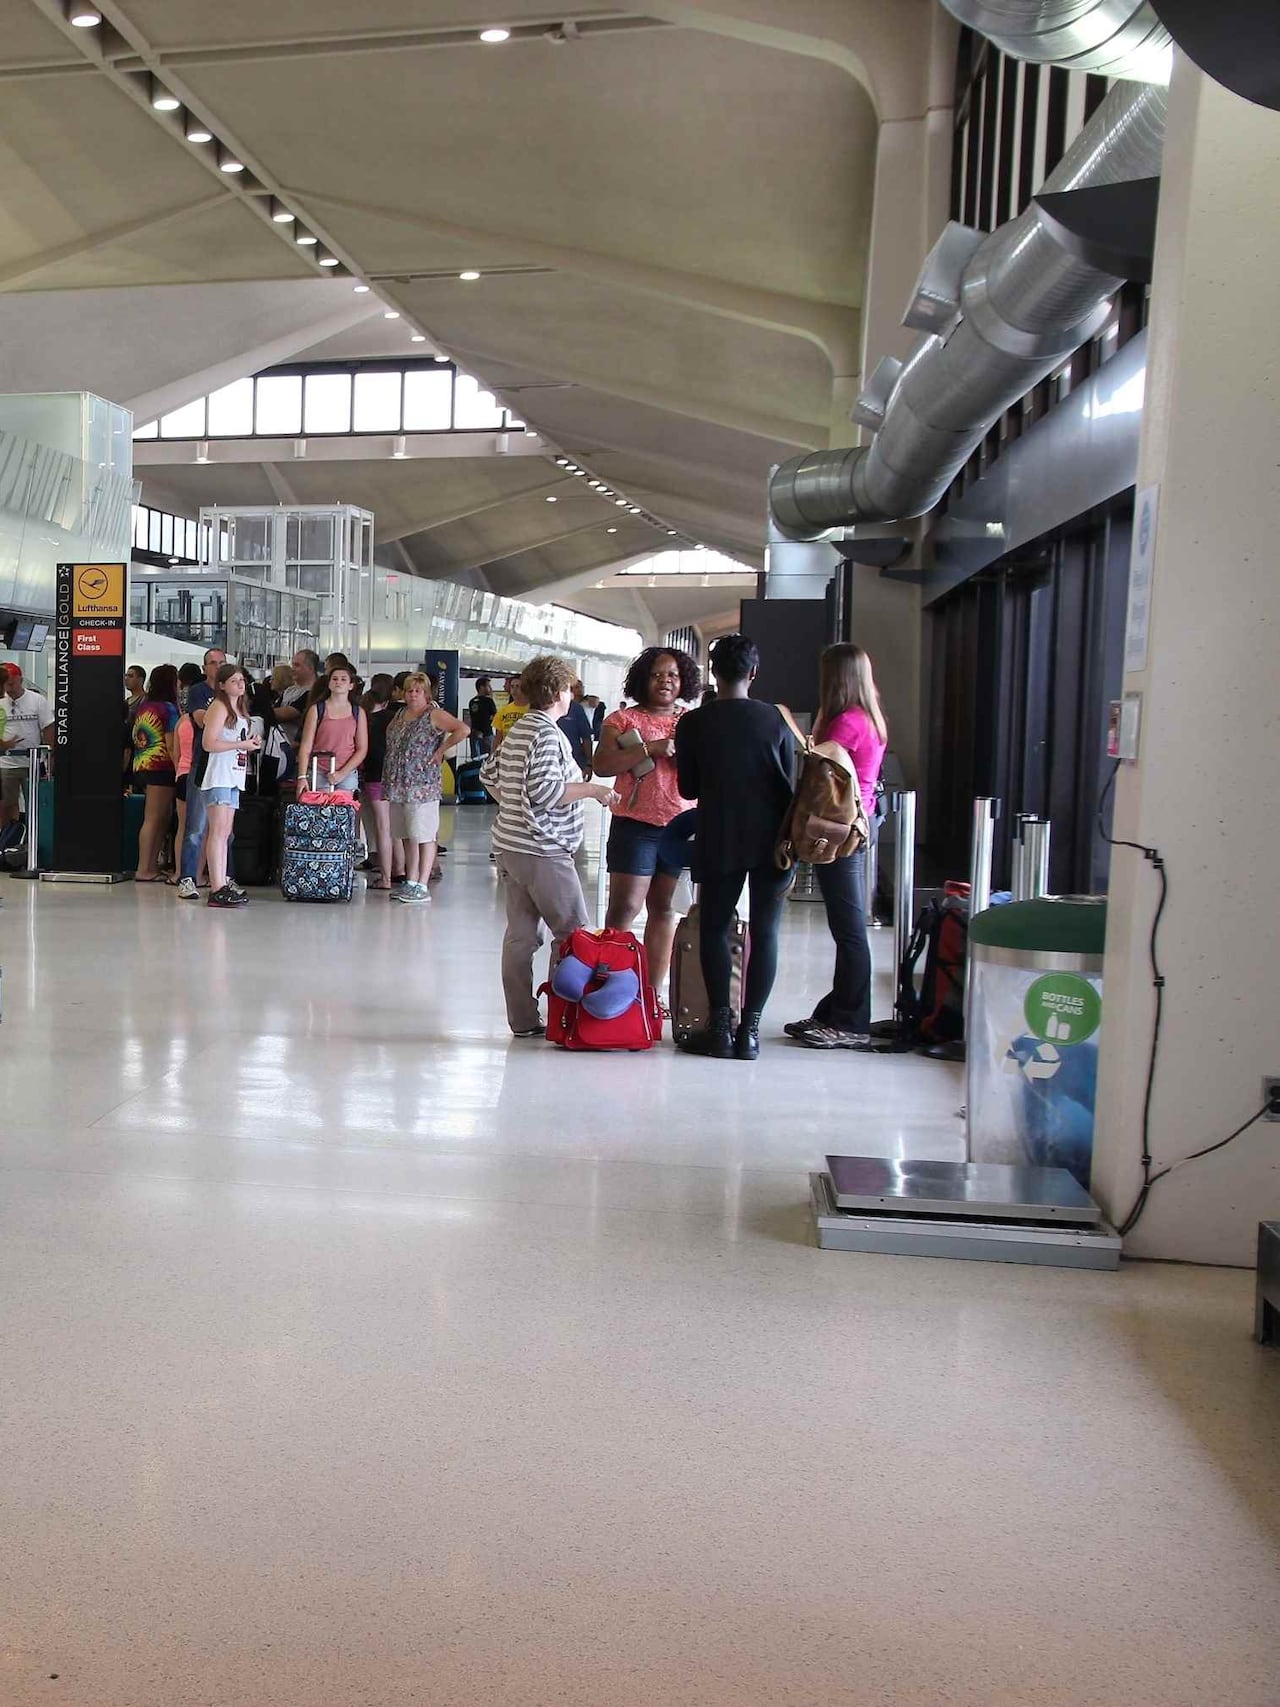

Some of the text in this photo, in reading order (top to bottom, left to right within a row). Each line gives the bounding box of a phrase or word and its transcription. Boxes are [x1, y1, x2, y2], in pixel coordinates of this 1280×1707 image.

[77, 604, 118, 612] Lufthansa
[77, 635, 97, 643] First
[77, 643, 101, 651] Class
[58, 584, 70, 745] STAR ALLIANCE GOLD
[438, 671, 446, 704] AIRWAYS
[1042, 991, 1084, 1006] BOTTLES
[1056, 1003, 1084, 1016] CANS
